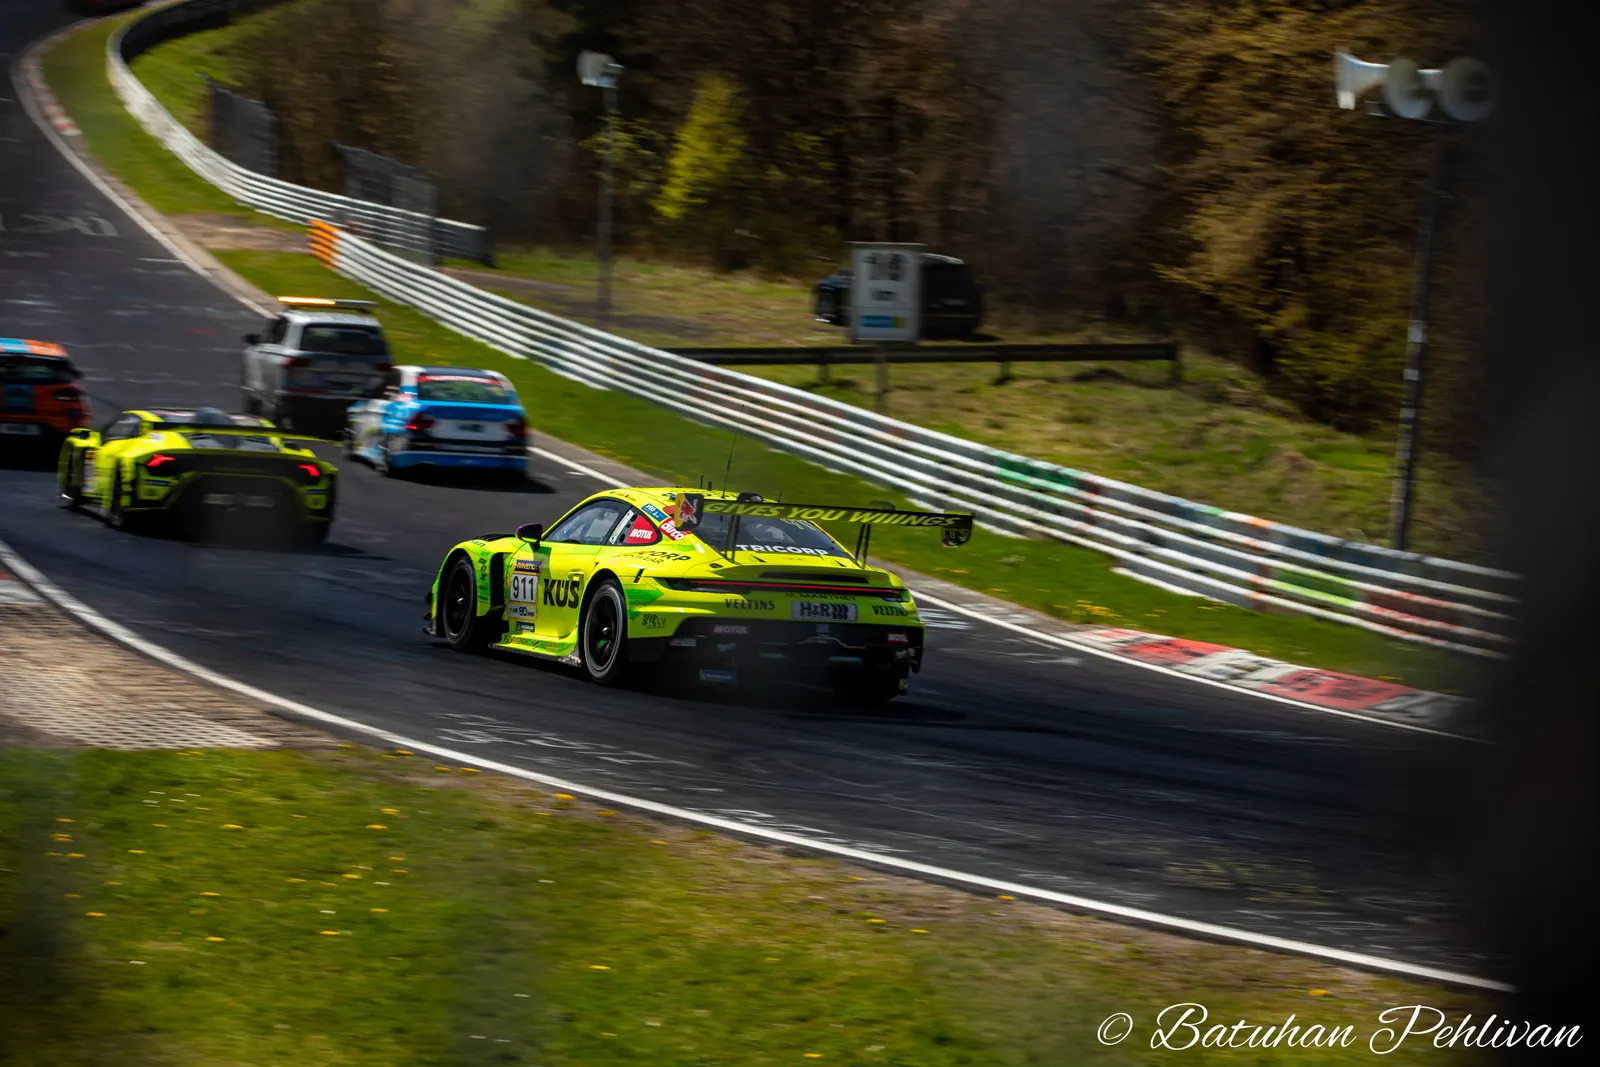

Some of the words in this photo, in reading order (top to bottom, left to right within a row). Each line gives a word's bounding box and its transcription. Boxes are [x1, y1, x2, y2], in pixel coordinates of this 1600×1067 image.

[703, 502, 785, 517] GIVES
[787, 507, 848, 521] YOU
[630, 528, 653, 540] MOTUL
[735, 544, 829, 556] TRICORP
[513, 575, 535, 601] 911
[543, 578, 581, 609] KÜS
[725, 598, 776, 611] VELTINS
